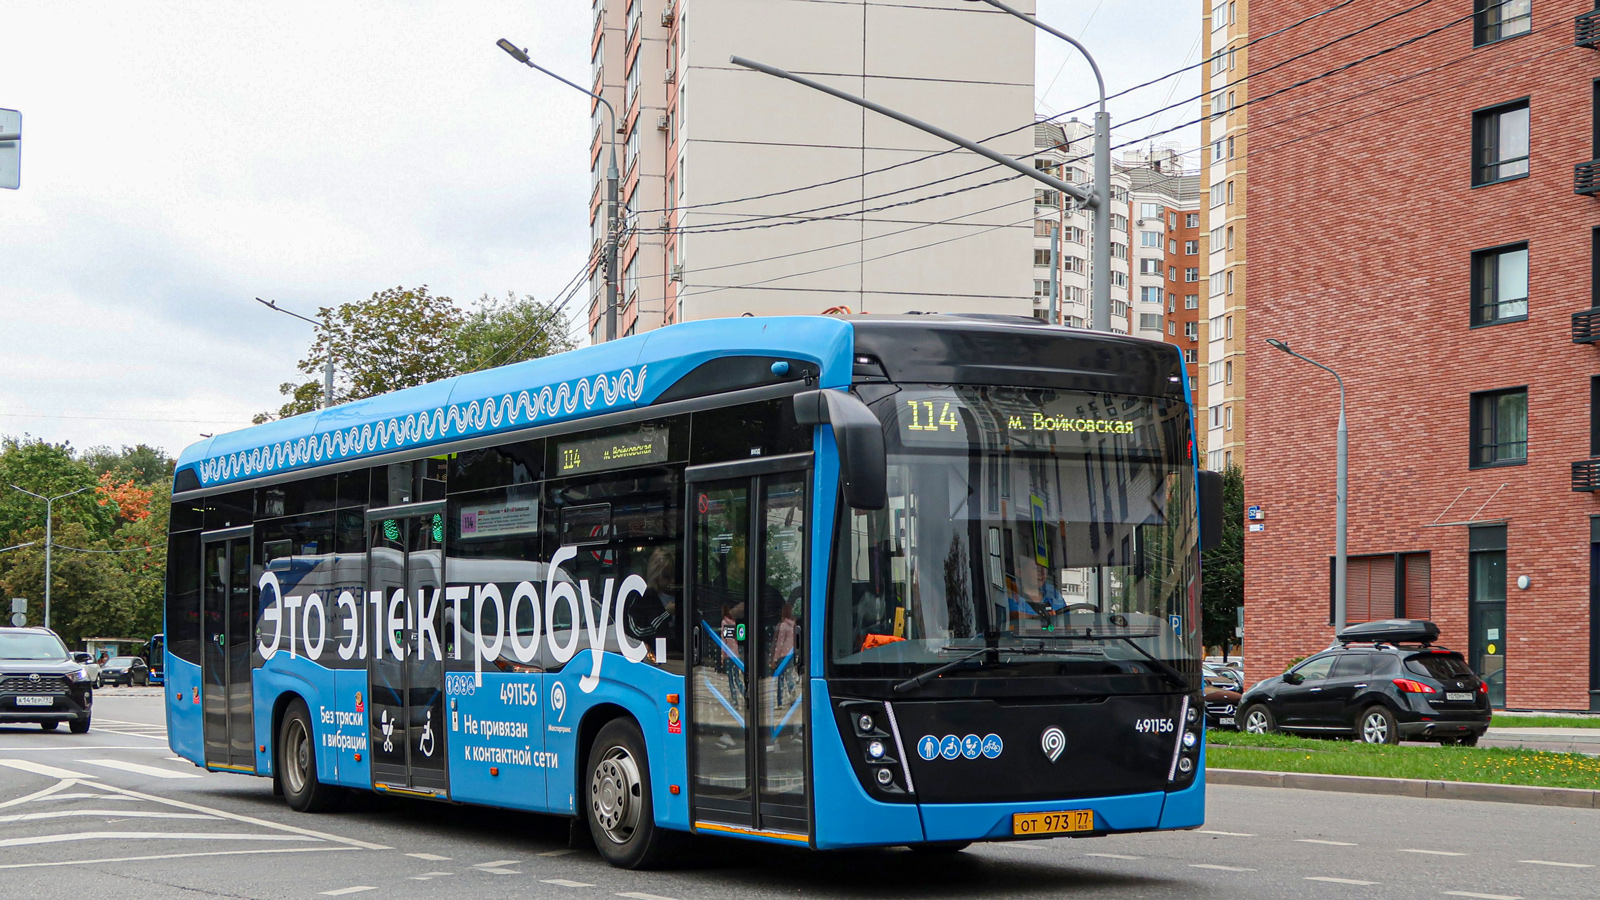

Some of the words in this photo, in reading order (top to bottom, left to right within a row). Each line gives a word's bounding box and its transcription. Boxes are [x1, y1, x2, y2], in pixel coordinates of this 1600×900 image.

[907, 400, 958, 432] 114
[1008, 415, 1026, 430] м.
[1032, 412, 1134, 434] Войковская
[563, 448, 581, 470] 114
[258, 571, 326, 660] Это
[338, 546, 667, 693] электробус.
[500, 682, 538, 707] 491156
[320, 706, 334, 724] Без
[335, 711, 363, 729] тряски
[463, 714, 478, 735] Не
[480, 720, 528, 740] привязан
[1135, 718, 1174, 733] 491156
[323, 734, 327, 747] и
[327, 729, 367, 752] вибраций
[464, 745, 471, 760] к
[472, 745, 531, 766] контактной
[533, 751, 559, 769] сети
[1021, 819, 1038, 832] ОТ
[1044, 814, 1069, 831] 973
[1076, 812, 1089, 825] 77
